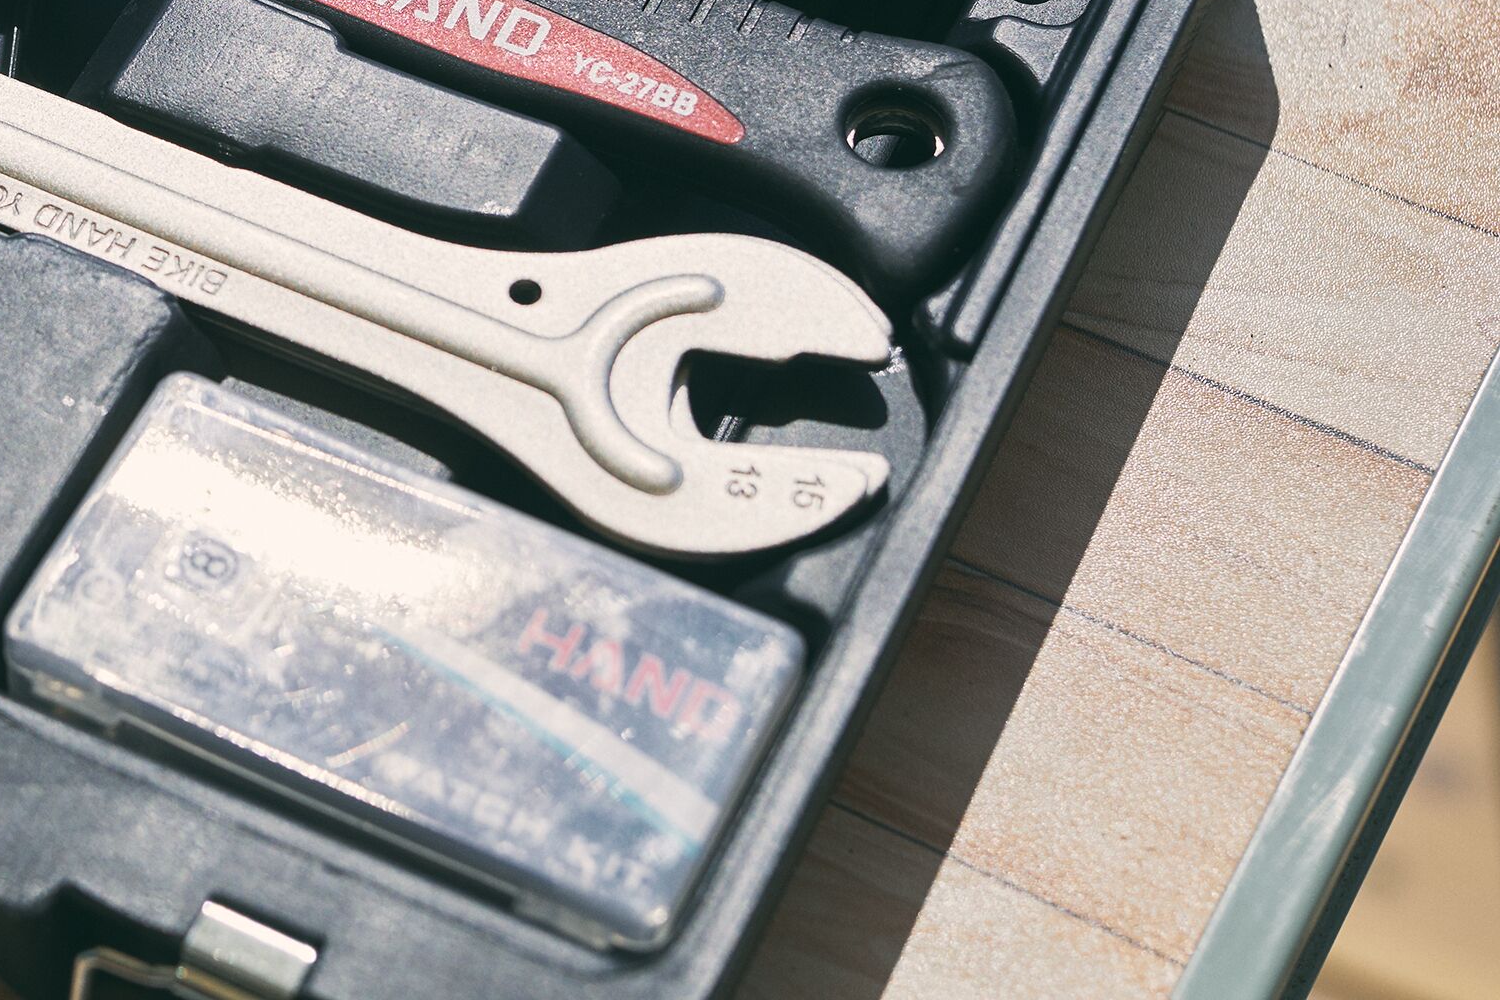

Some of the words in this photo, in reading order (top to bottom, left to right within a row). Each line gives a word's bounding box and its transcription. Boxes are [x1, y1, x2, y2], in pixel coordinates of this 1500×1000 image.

[573, 52, 698, 116] YC-27BB
[34, 203, 137, 259] HAND
[141, 245, 228, 295] BIKE
[724, 464, 762, 501] 13
[792, 474, 827, 511] 15
[518, 607, 742, 742] HAND
